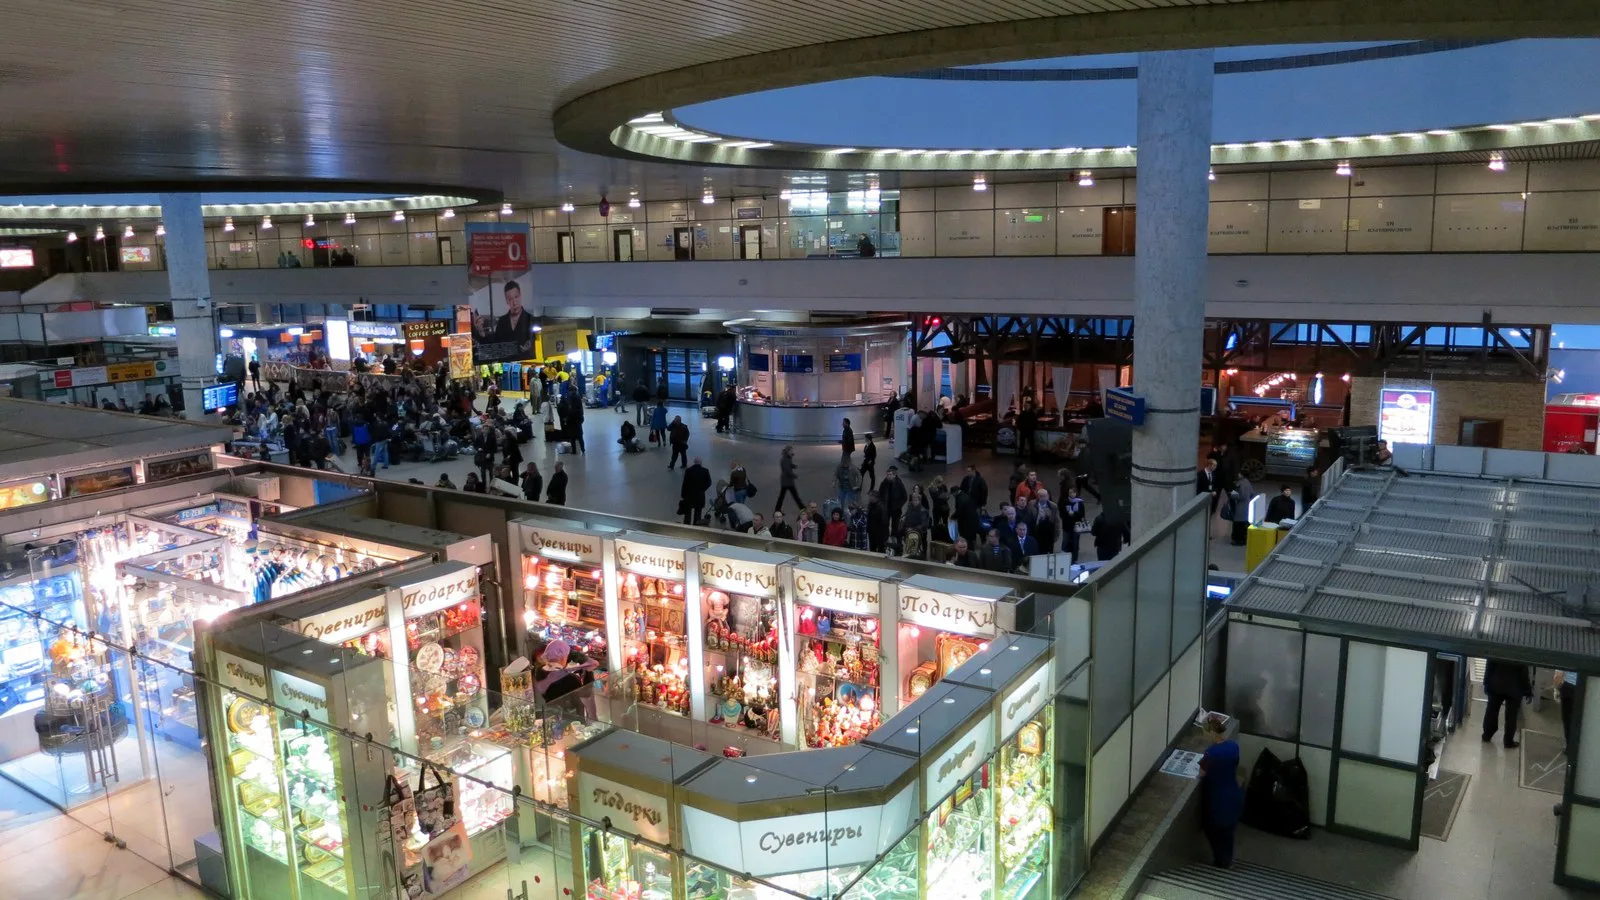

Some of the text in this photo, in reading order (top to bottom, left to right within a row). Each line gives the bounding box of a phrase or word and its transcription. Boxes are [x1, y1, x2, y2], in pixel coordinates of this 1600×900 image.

[408, 328, 446, 338] COFFEE SHOP
[531, 531, 593, 554] Сувениры
[618, 545, 685, 572] Сувениры
[702, 561, 777, 589] Подарки
[795, 574, 879, 607] Сувениры
[404, 577, 477, 610] Подарки
[301, 604, 386, 640] Сувениры
[901, 594, 995, 628] Подарки
[593, 788, 662, 825] Подарки
[759, 824, 863, 854] Сувениры
